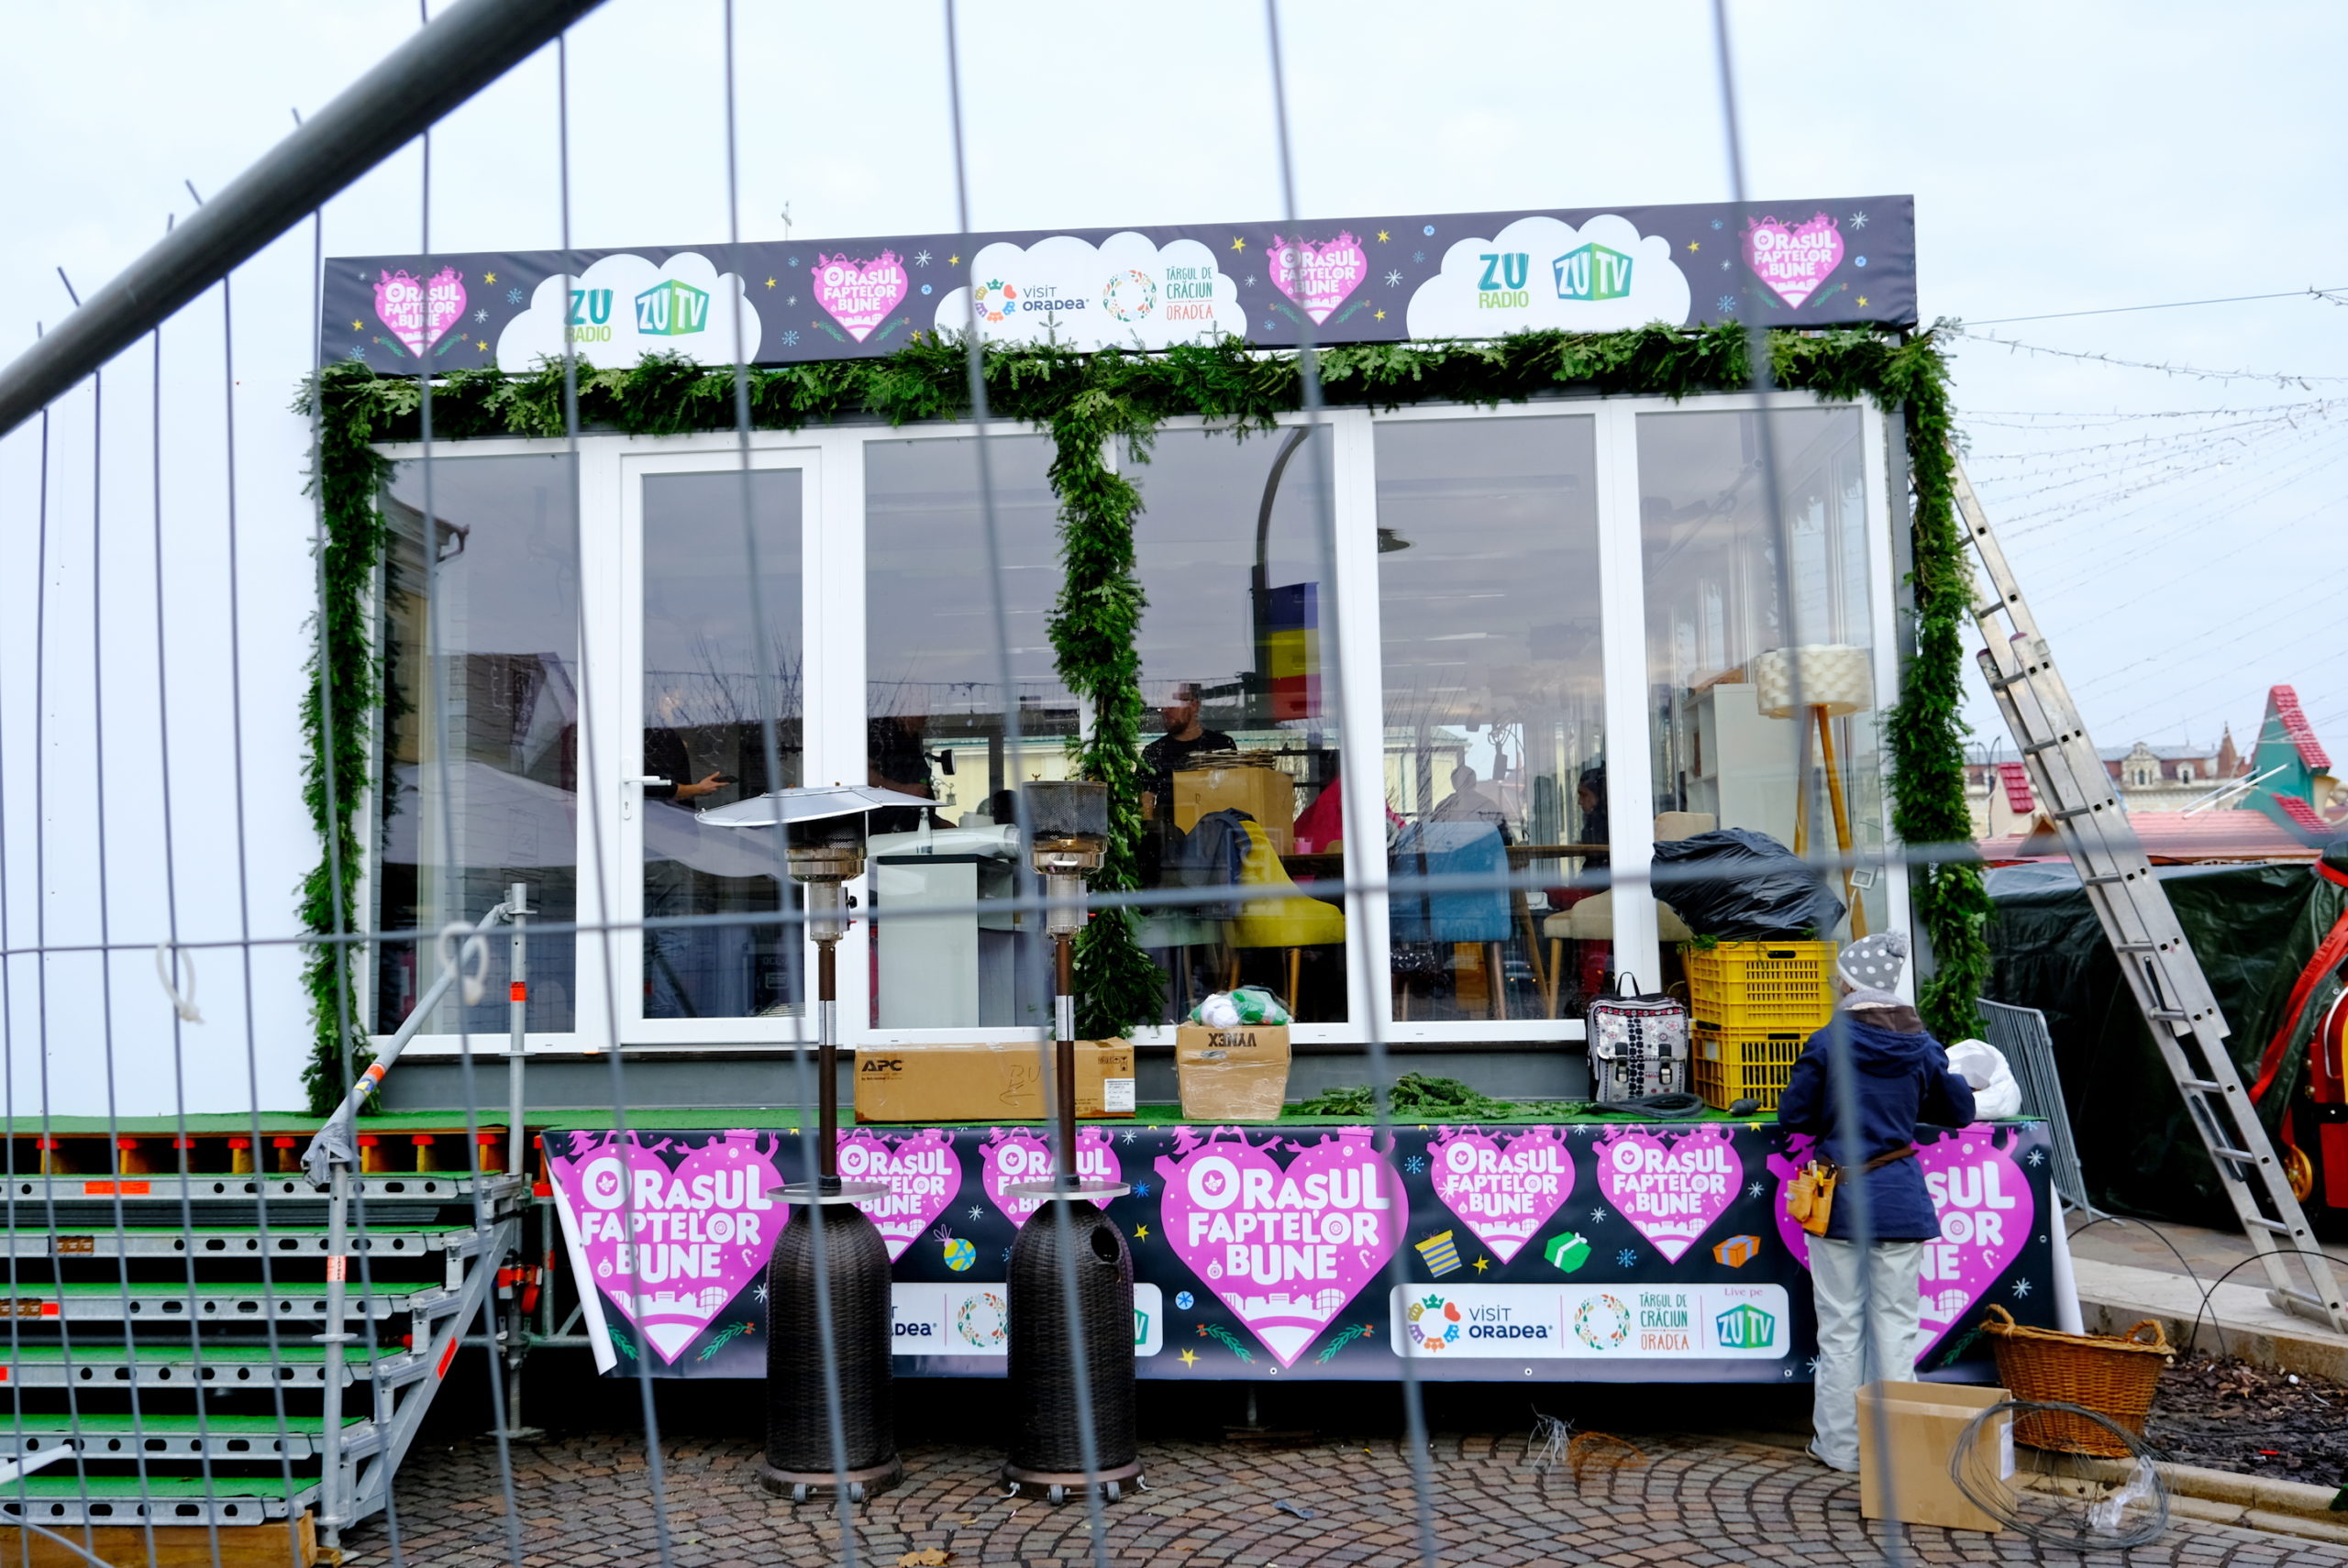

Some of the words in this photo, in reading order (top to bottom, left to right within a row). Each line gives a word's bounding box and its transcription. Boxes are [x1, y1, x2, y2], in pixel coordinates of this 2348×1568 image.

[1754, 248, 1833, 266] FAPTELOR
[1202, 267, 1213, 280] DE
[1279, 266, 1356, 283] FAPTELOR
[1478, 252, 1529, 291] ZU
[1768, 262, 1816, 279] BUNE
[823, 284, 897, 301] FAPTELOR
[1167, 281, 1213, 300] CRĂCIUN
[564, 288, 614, 326] ZU
[837, 297, 880, 314] BUNE
[1479, 291, 1530, 309] RADIO
[1166, 304, 1213, 321] ORADEA
[564, 326, 612, 343] RADIO
[1208, 1032, 1257, 1048] VYNEX
[861, 1059, 903, 1076] APC
[1446, 1174, 1559, 1195] FAPTELOR
[1612, 1174, 1726, 1195] FAPTELOR
[860, 1195, 922, 1218] BUNE
[1469, 1193, 1534, 1217] BUNE
[1635, 1193, 1702, 1217] BUNE
[581, 1211, 761, 1246] FAPTELOR
[1188, 1211, 1379, 1247] FAPTELOR
[615, 1243, 722, 1284] BUNE
[1226, 1243, 1337, 1285] BUNE
[1677, 1294, 1688, 1308] DE
[1724, 1288, 1746, 1297] Live
[1749, 1289, 1763, 1297] pe
[1640, 1308, 1688, 1328] CRĂCIUN
[1641, 1334, 1689, 1351] ORADEA
